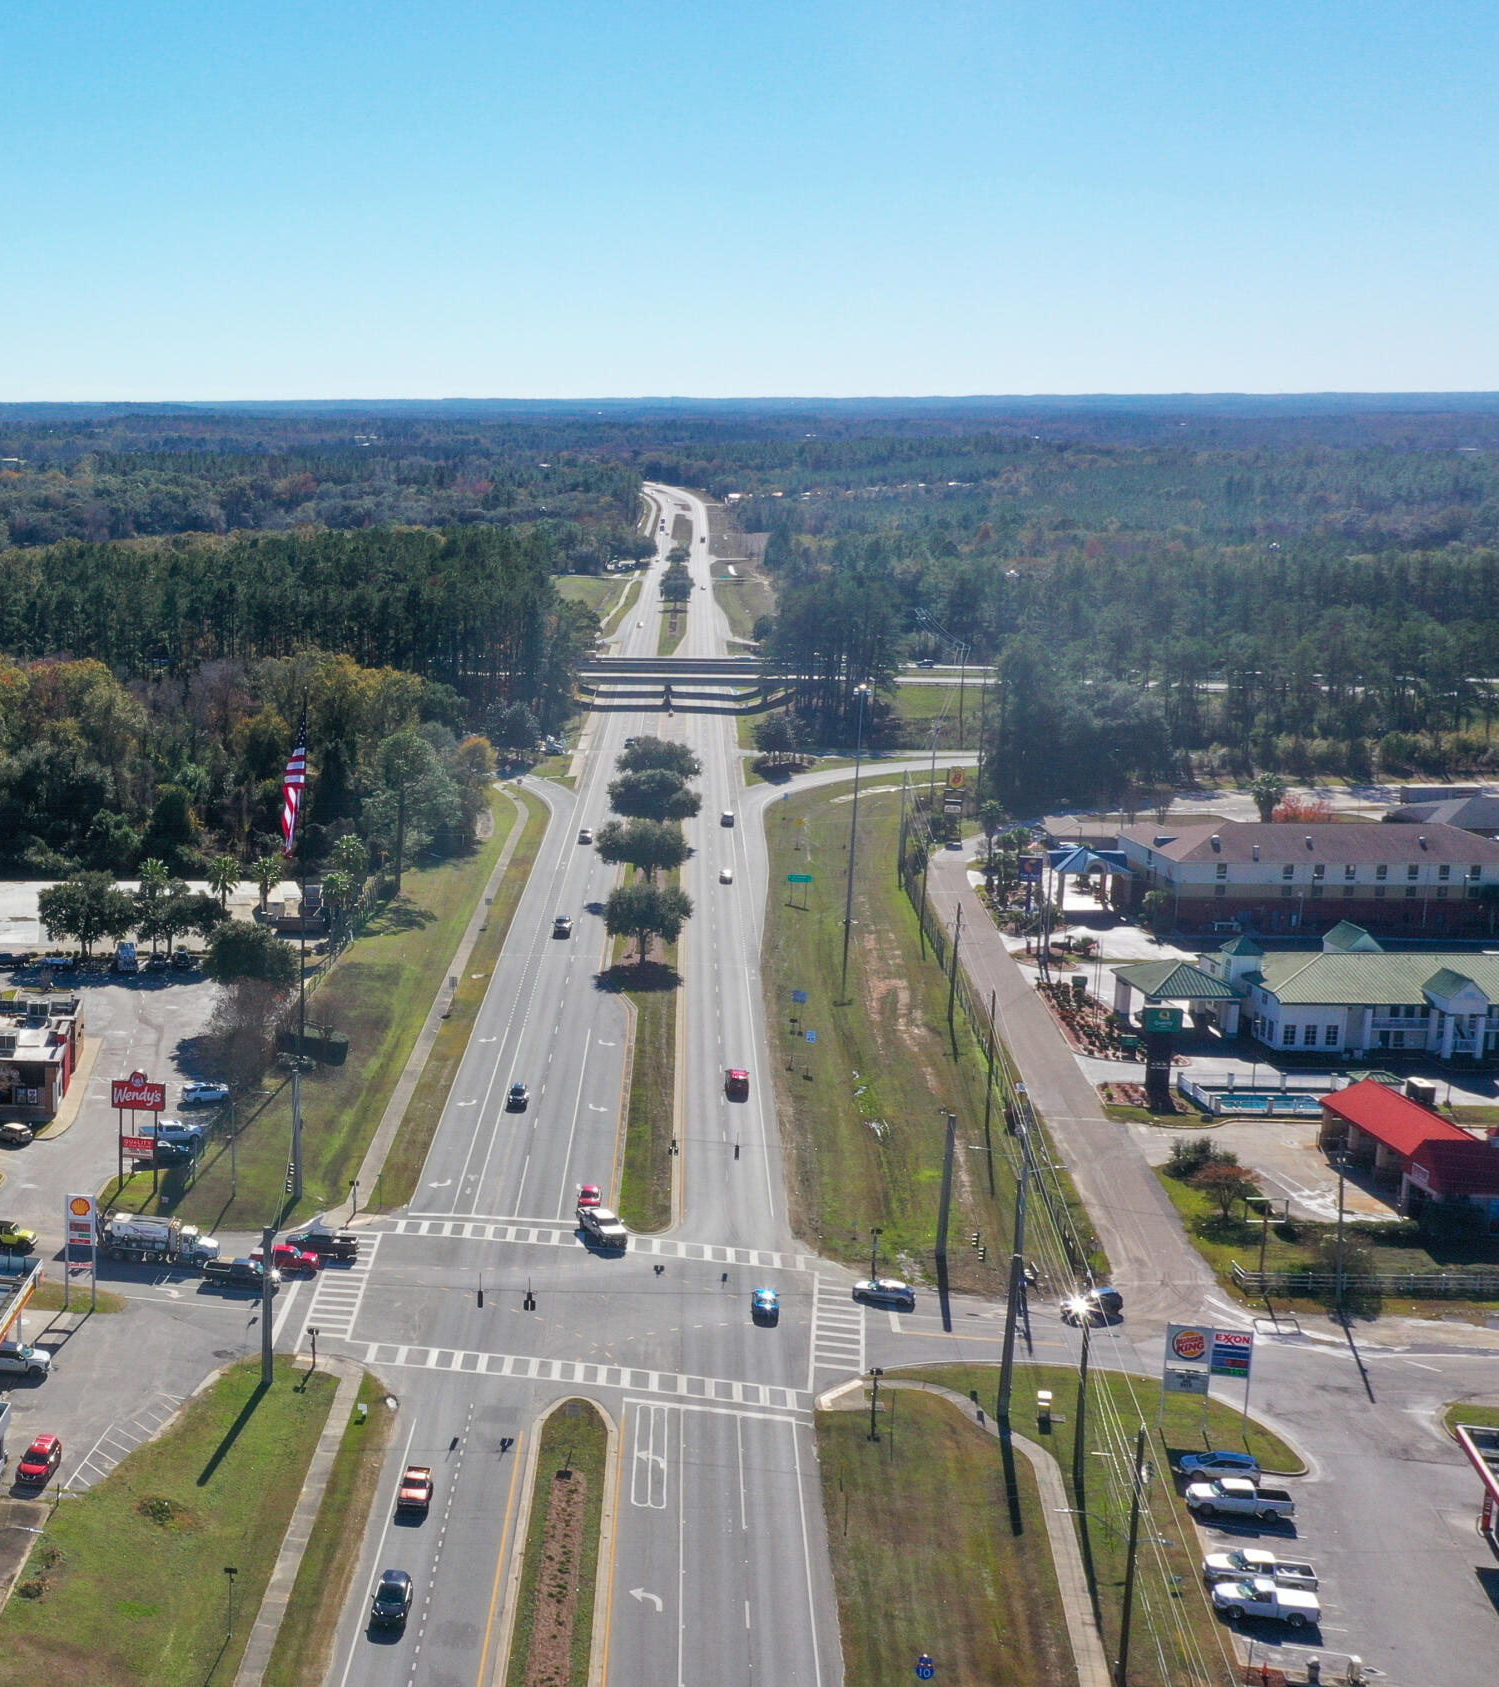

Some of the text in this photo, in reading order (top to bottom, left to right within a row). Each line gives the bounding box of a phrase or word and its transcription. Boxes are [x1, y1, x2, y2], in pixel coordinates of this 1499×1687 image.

[113, 1086, 161, 1107] Wendy's
[124, 1138, 153, 1146] QUALITY
[1175, 1335, 1205, 1346] BURGER
[1215, 1333, 1251, 1346] EXXON
[1176, 1341, 1205, 1353] KING
[919, 1668, 931, 1678] 10
